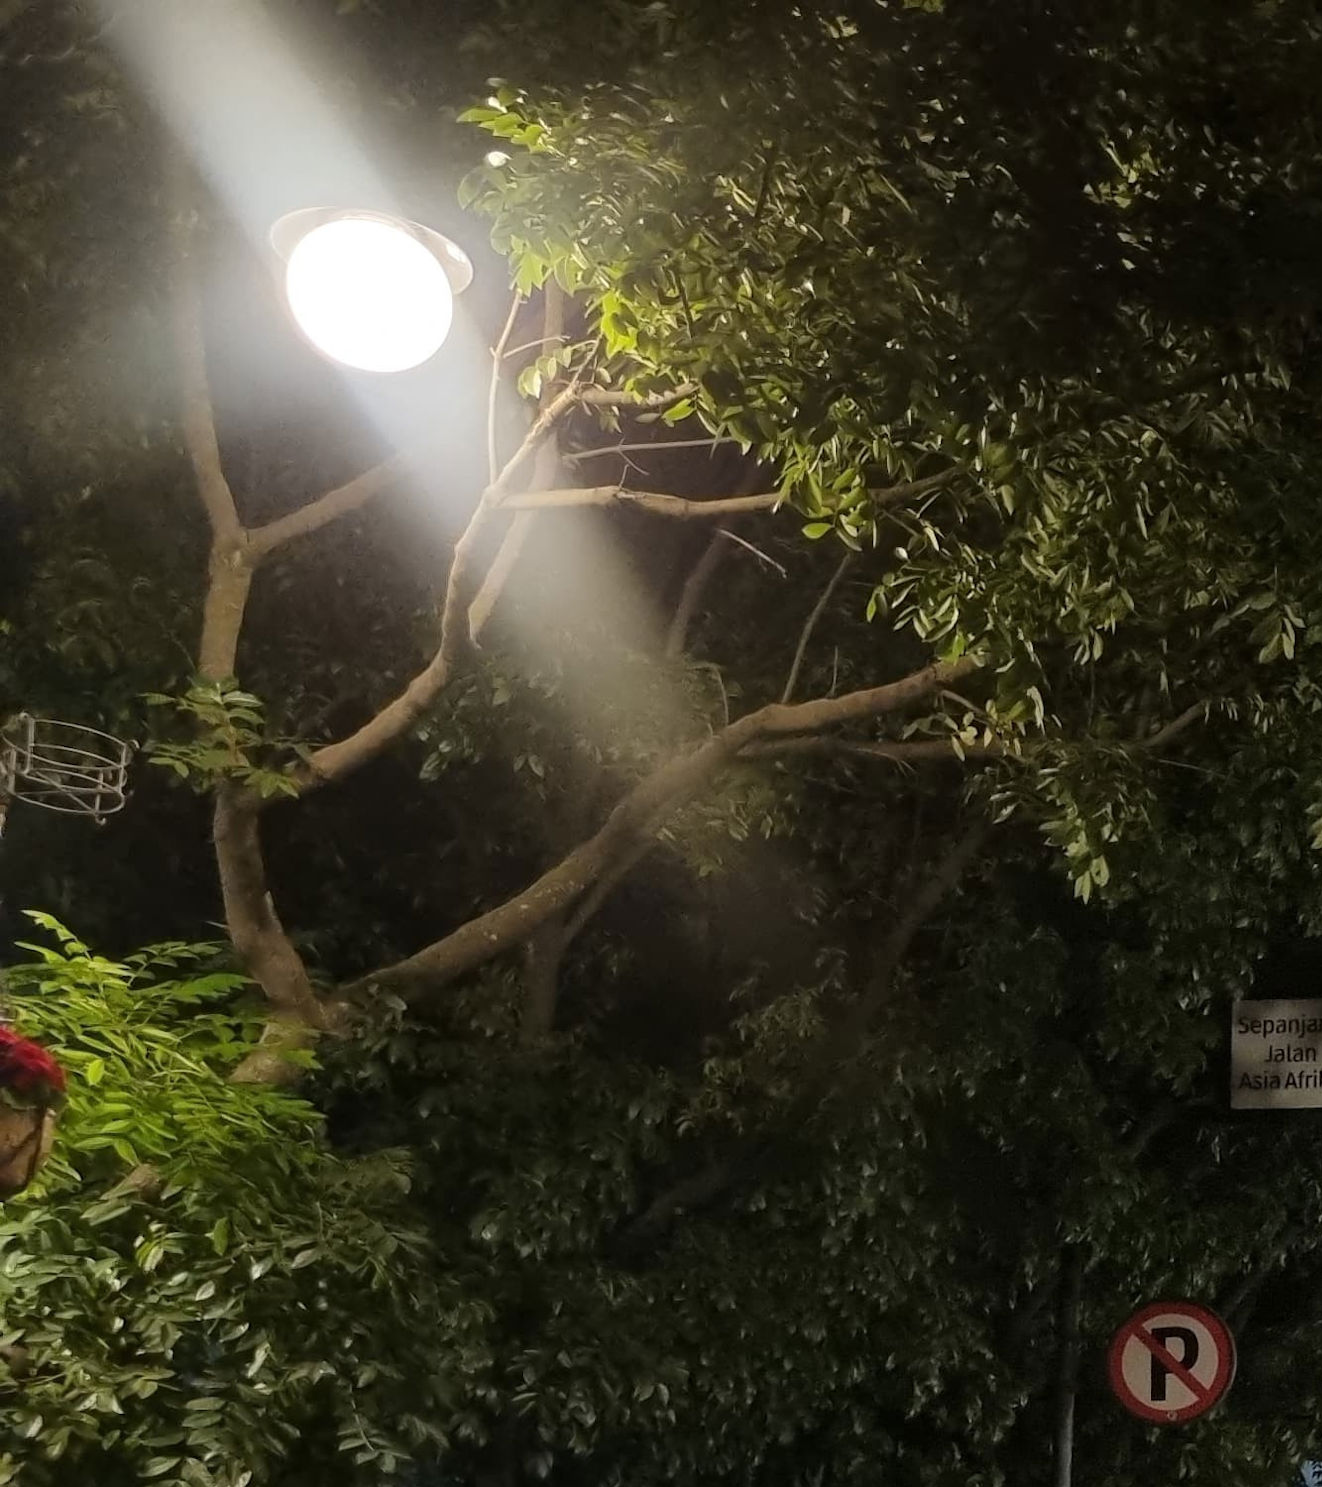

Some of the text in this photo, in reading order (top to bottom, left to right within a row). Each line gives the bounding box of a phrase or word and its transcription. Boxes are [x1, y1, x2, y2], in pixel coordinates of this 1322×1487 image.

[1264, 1044, 1317, 1063] Jalan
[1239, 1071, 1280, 1089] Asia
[1150, 1327, 1199, 1401] P
